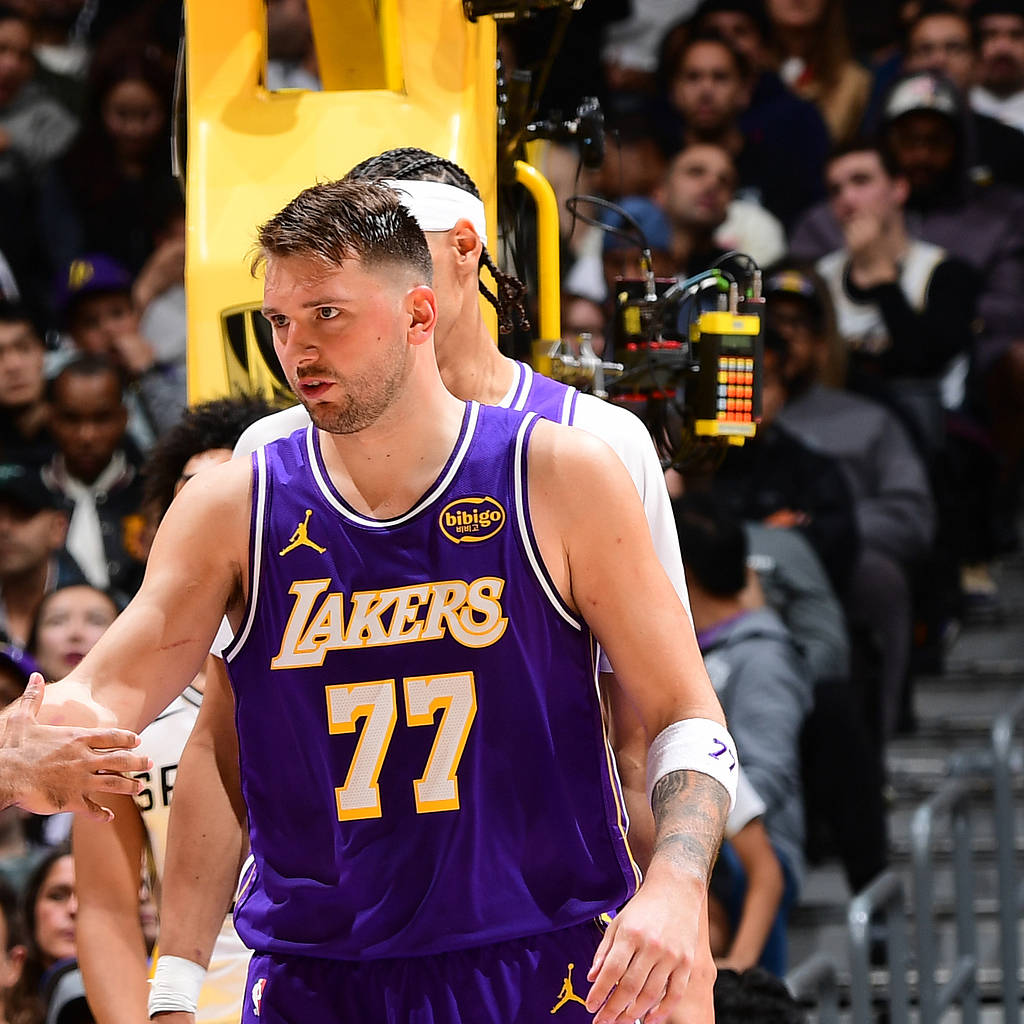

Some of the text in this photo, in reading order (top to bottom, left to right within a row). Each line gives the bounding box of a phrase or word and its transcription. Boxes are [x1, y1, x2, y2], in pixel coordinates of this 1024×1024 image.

[445, 508, 501, 527] bibigo
[271, 577, 508, 669] LAKERS
[325, 671, 477, 821] 77
